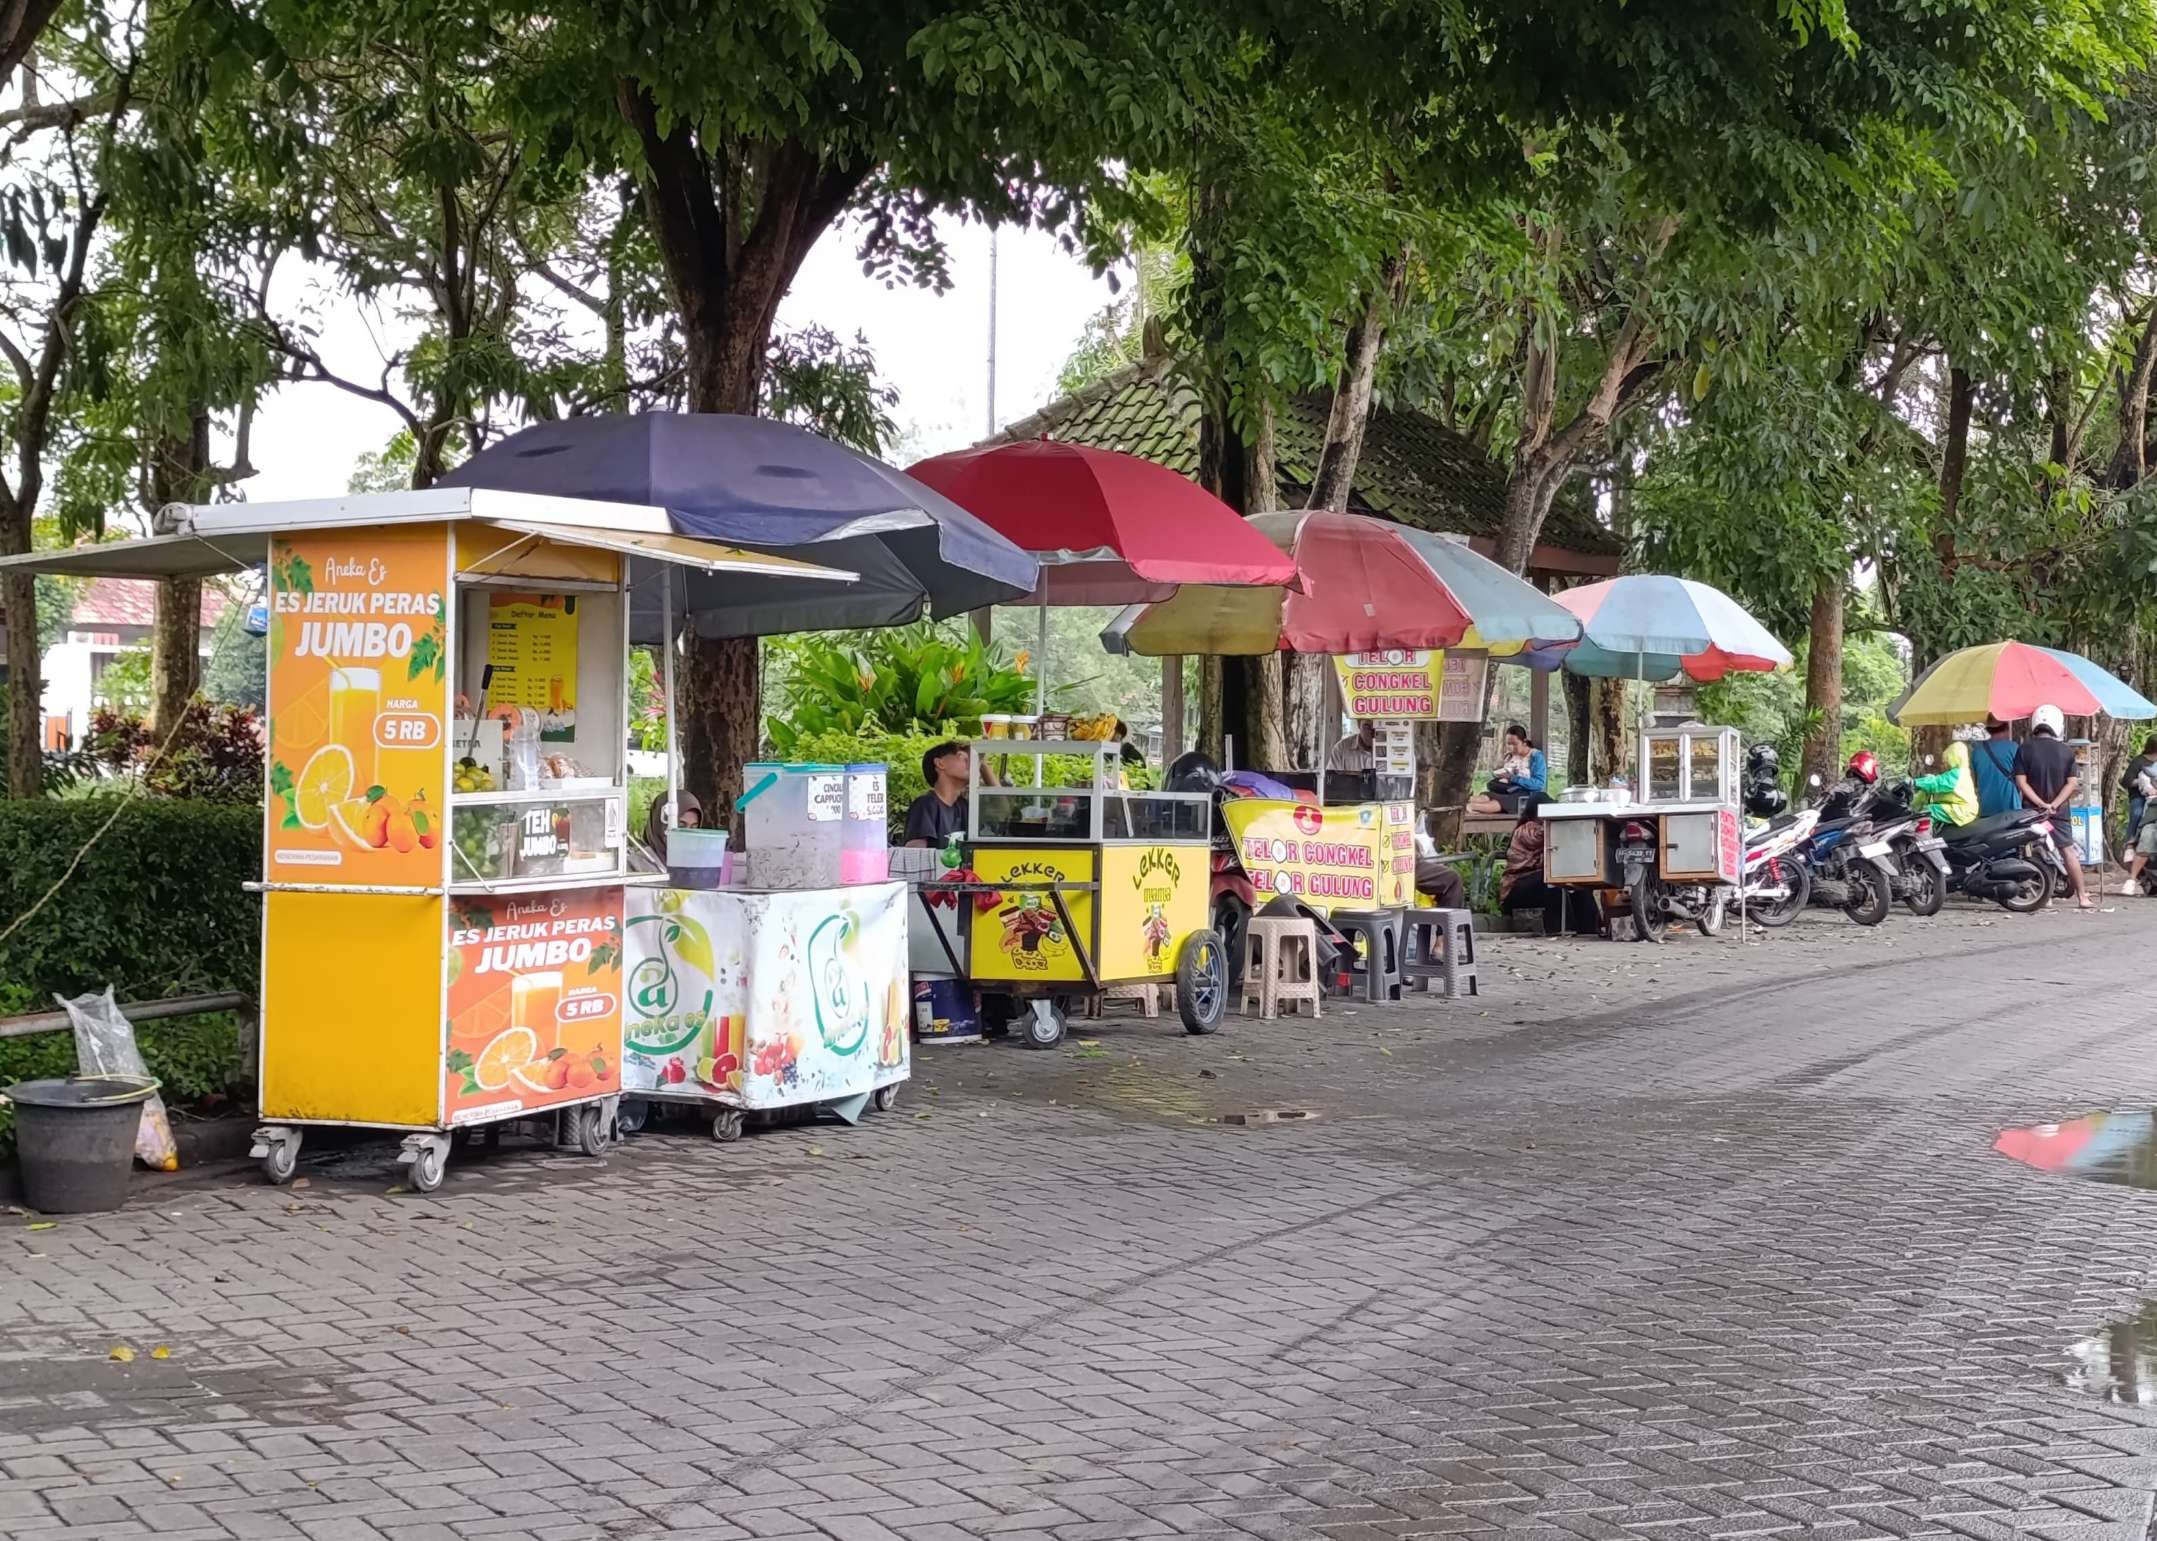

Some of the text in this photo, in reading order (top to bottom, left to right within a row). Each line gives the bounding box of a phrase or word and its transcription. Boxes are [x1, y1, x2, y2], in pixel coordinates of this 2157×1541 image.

[325, 558, 366, 585] Aneka
[275, 592, 440, 616] ES JERUK PERAS
[295, 622, 412, 657] JUMBO
[1352, 672, 1432, 691] CONGKEL
[387, 699, 418, 709] HARGA
[1352, 695, 1433, 715] GULUNG
[384, 720, 426, 740] 5 RB
[525, 809, 550, 836] TEH
[519, 834, 557, 859] JUMBO
[1303, 841, 1374, 869] CONGKEL
[1309, 873, 1373, 899] GULUNG
[452, 916, 615, 947] ES JERUK PERAS
[475, 938, 592, 974] JUMBO
[566, 1000, 604, 1017] 5 RB
